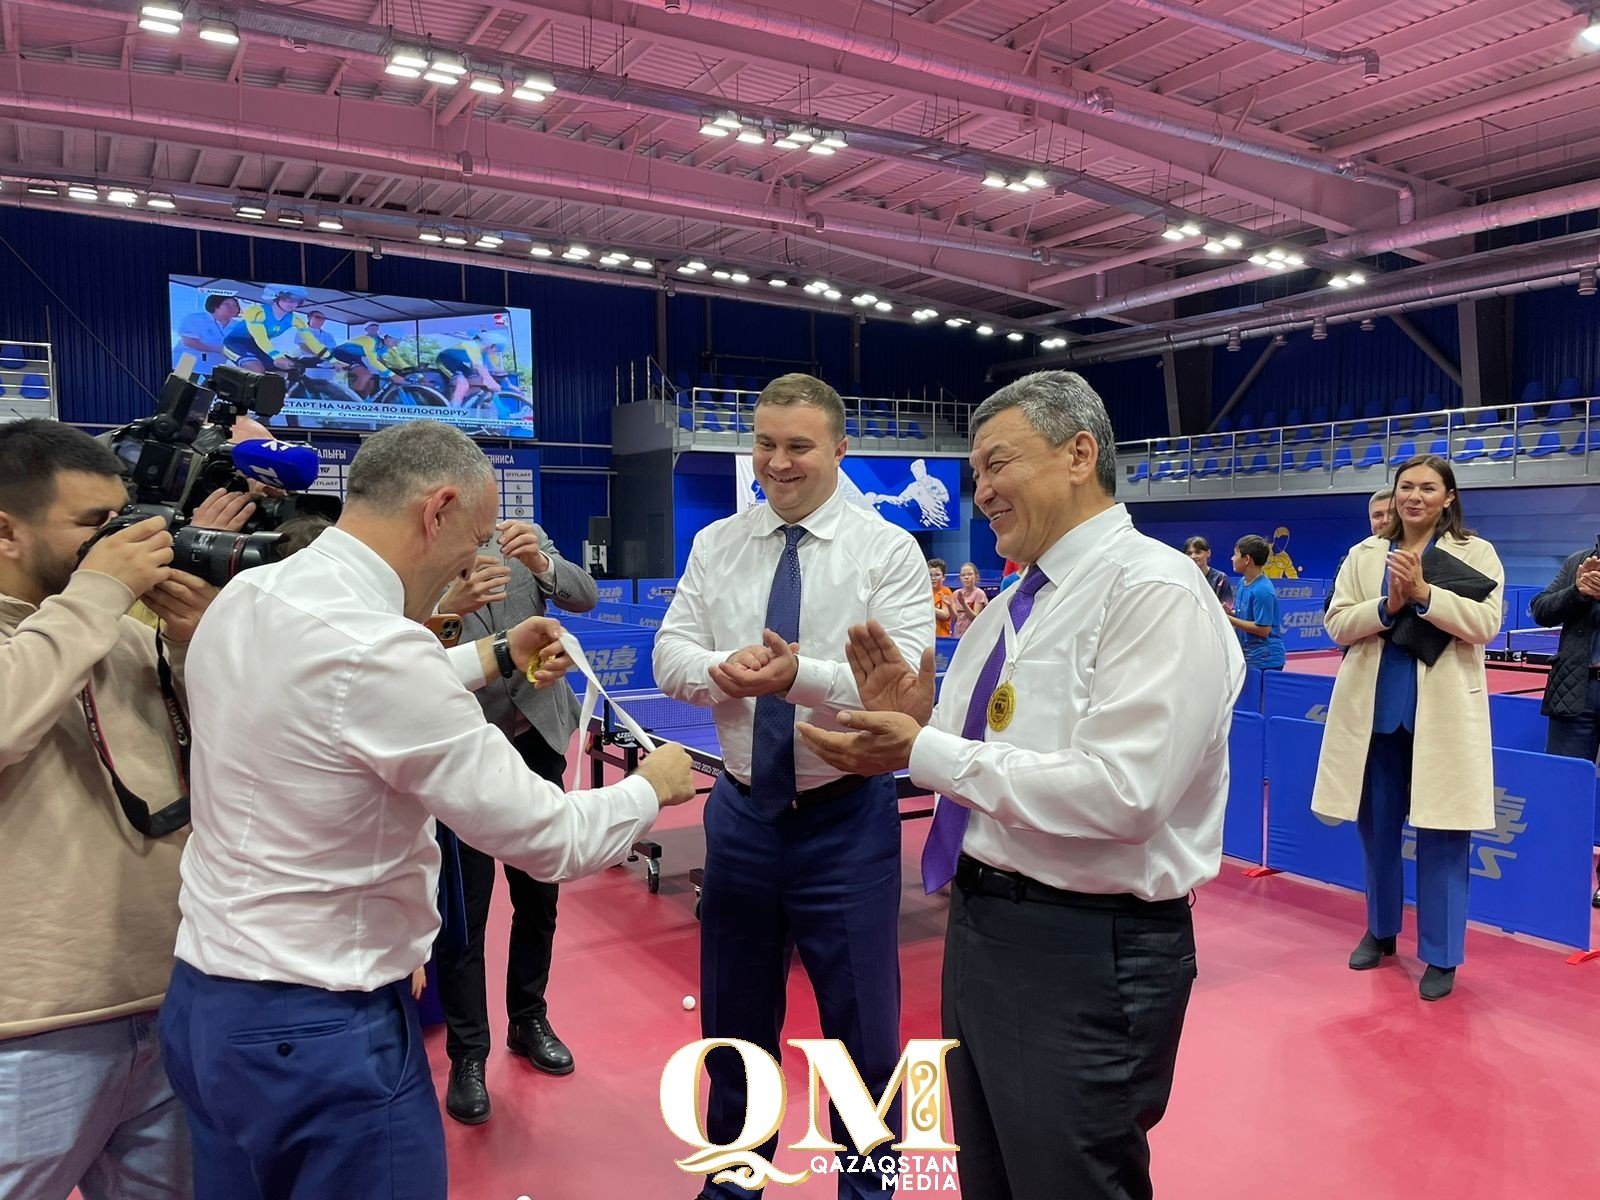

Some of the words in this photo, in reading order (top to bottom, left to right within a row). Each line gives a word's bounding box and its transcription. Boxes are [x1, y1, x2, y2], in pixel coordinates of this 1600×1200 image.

[319, 401, 335, 409] НА
[336, 403, 379, 412] ЧА-2024
[382, 405, 398, 413] ПО
[400, 407, 469, 417] ВЕЛОСПОРТУ
